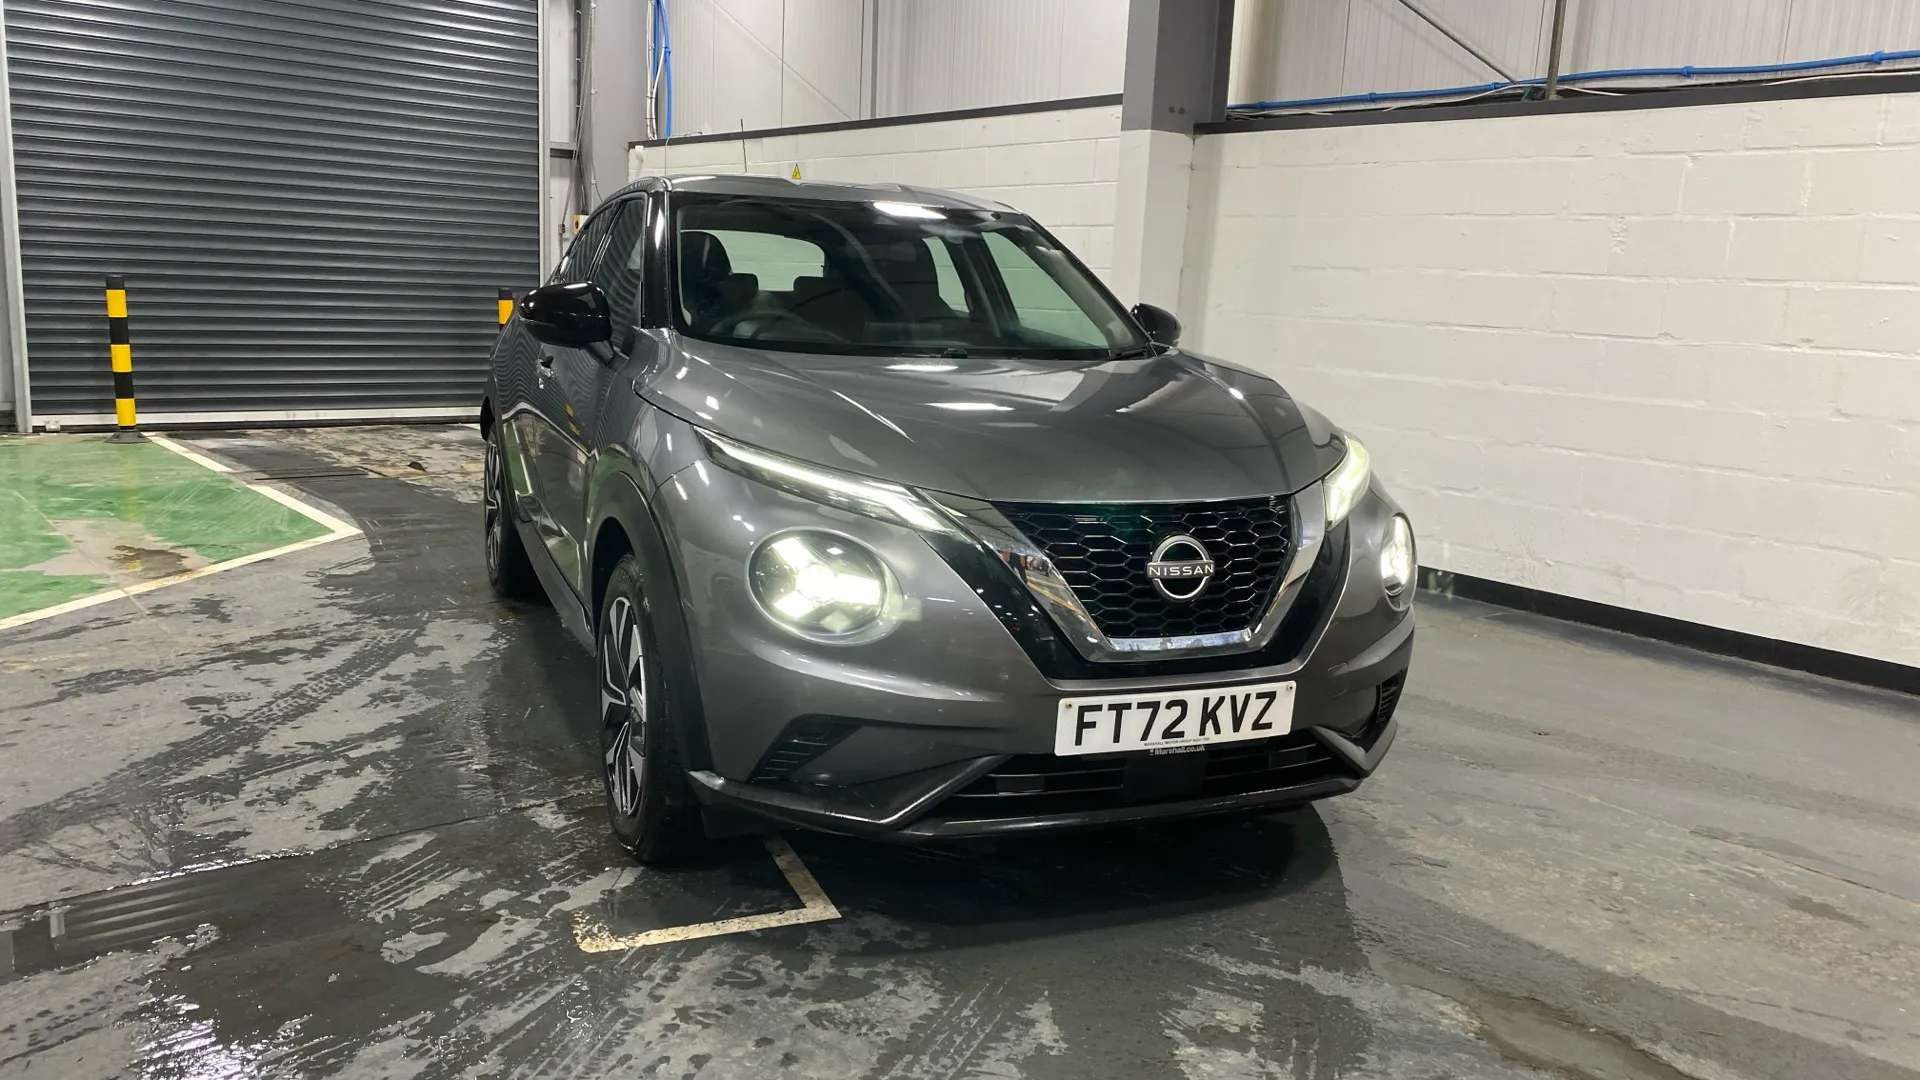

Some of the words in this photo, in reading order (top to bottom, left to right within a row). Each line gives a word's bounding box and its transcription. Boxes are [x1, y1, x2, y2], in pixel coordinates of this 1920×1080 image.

[1149, 564, 1214, 576] NISSAN
[1074, 699, 1188, 747] FT72
[1198, 690, 1277, 737] KVZ
